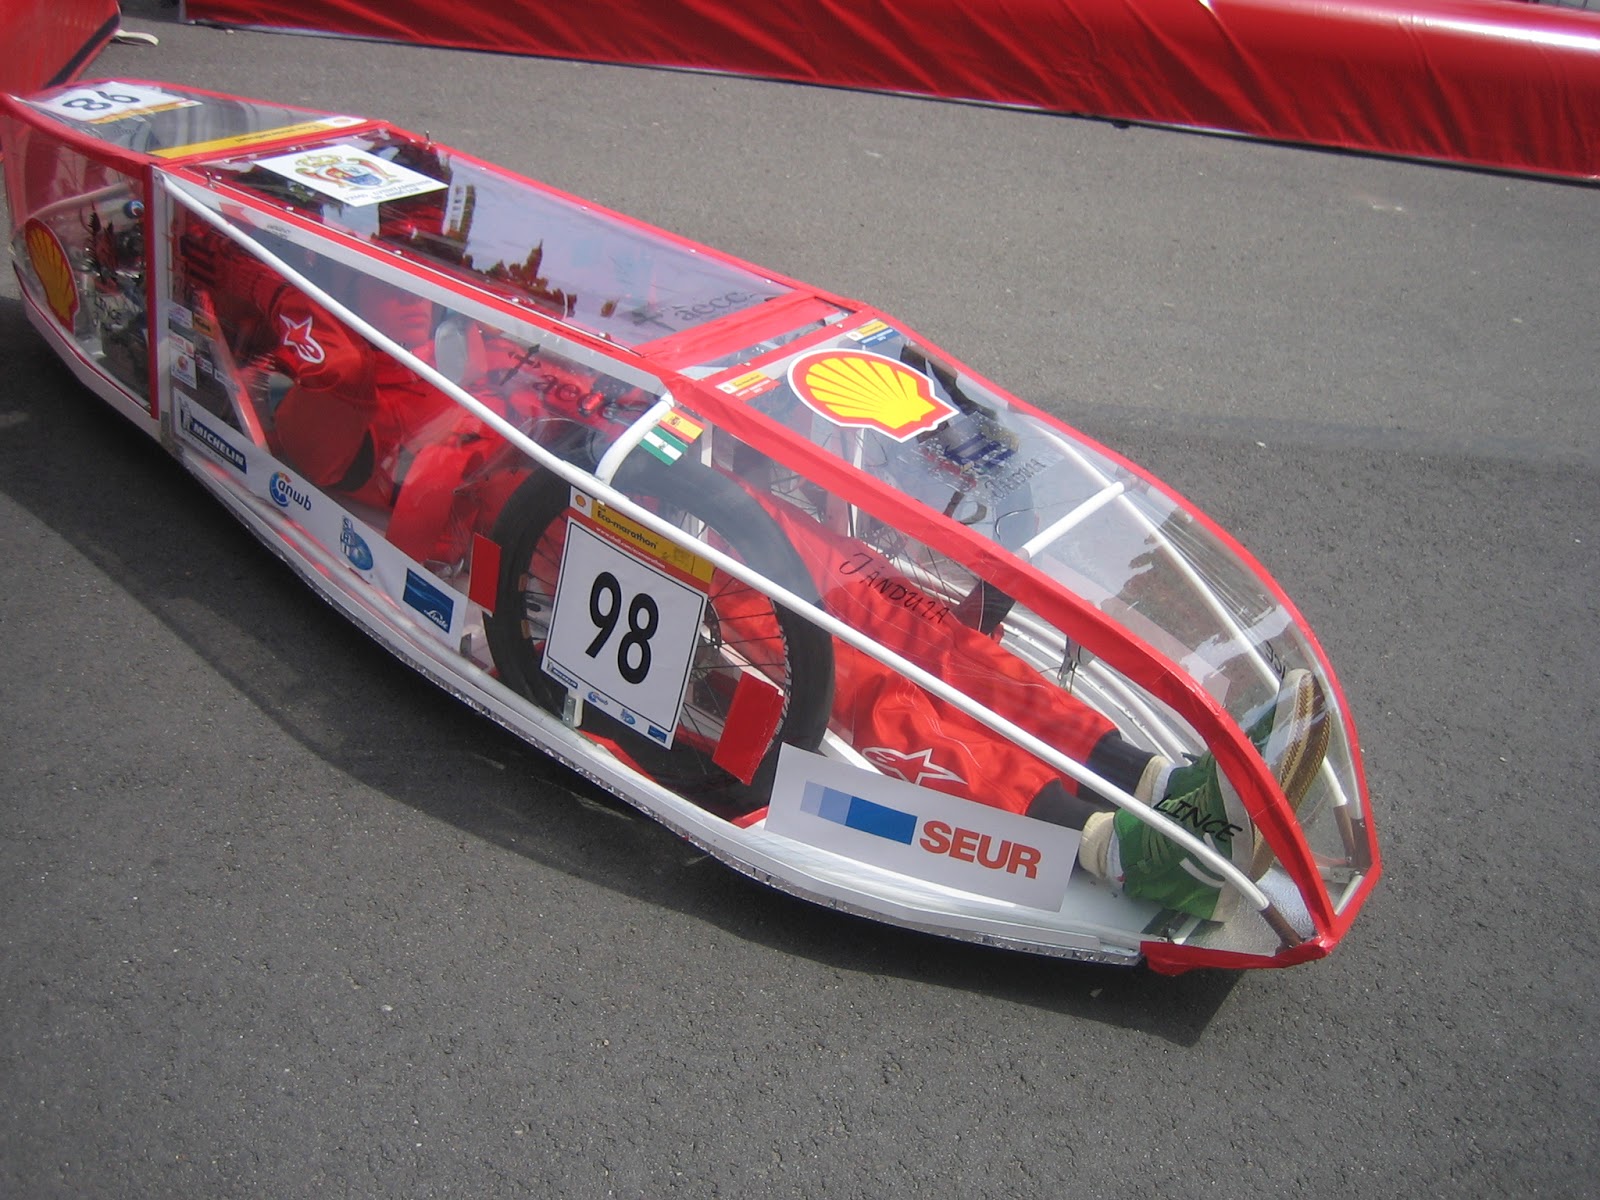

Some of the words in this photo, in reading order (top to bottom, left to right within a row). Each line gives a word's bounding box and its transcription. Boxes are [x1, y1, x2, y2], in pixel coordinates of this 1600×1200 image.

[193, 422, 245, 467] MICHELIN
[278, 480, 312, 511] anwb
[597, 510, 658, 550] Eco-marathon
[424, 608, 450, 630] Linde
[585, 571, 659, 685] 98
[1153, 793, 1243, 842] LINCE
[919, 819, 1042, 880] SEUR
